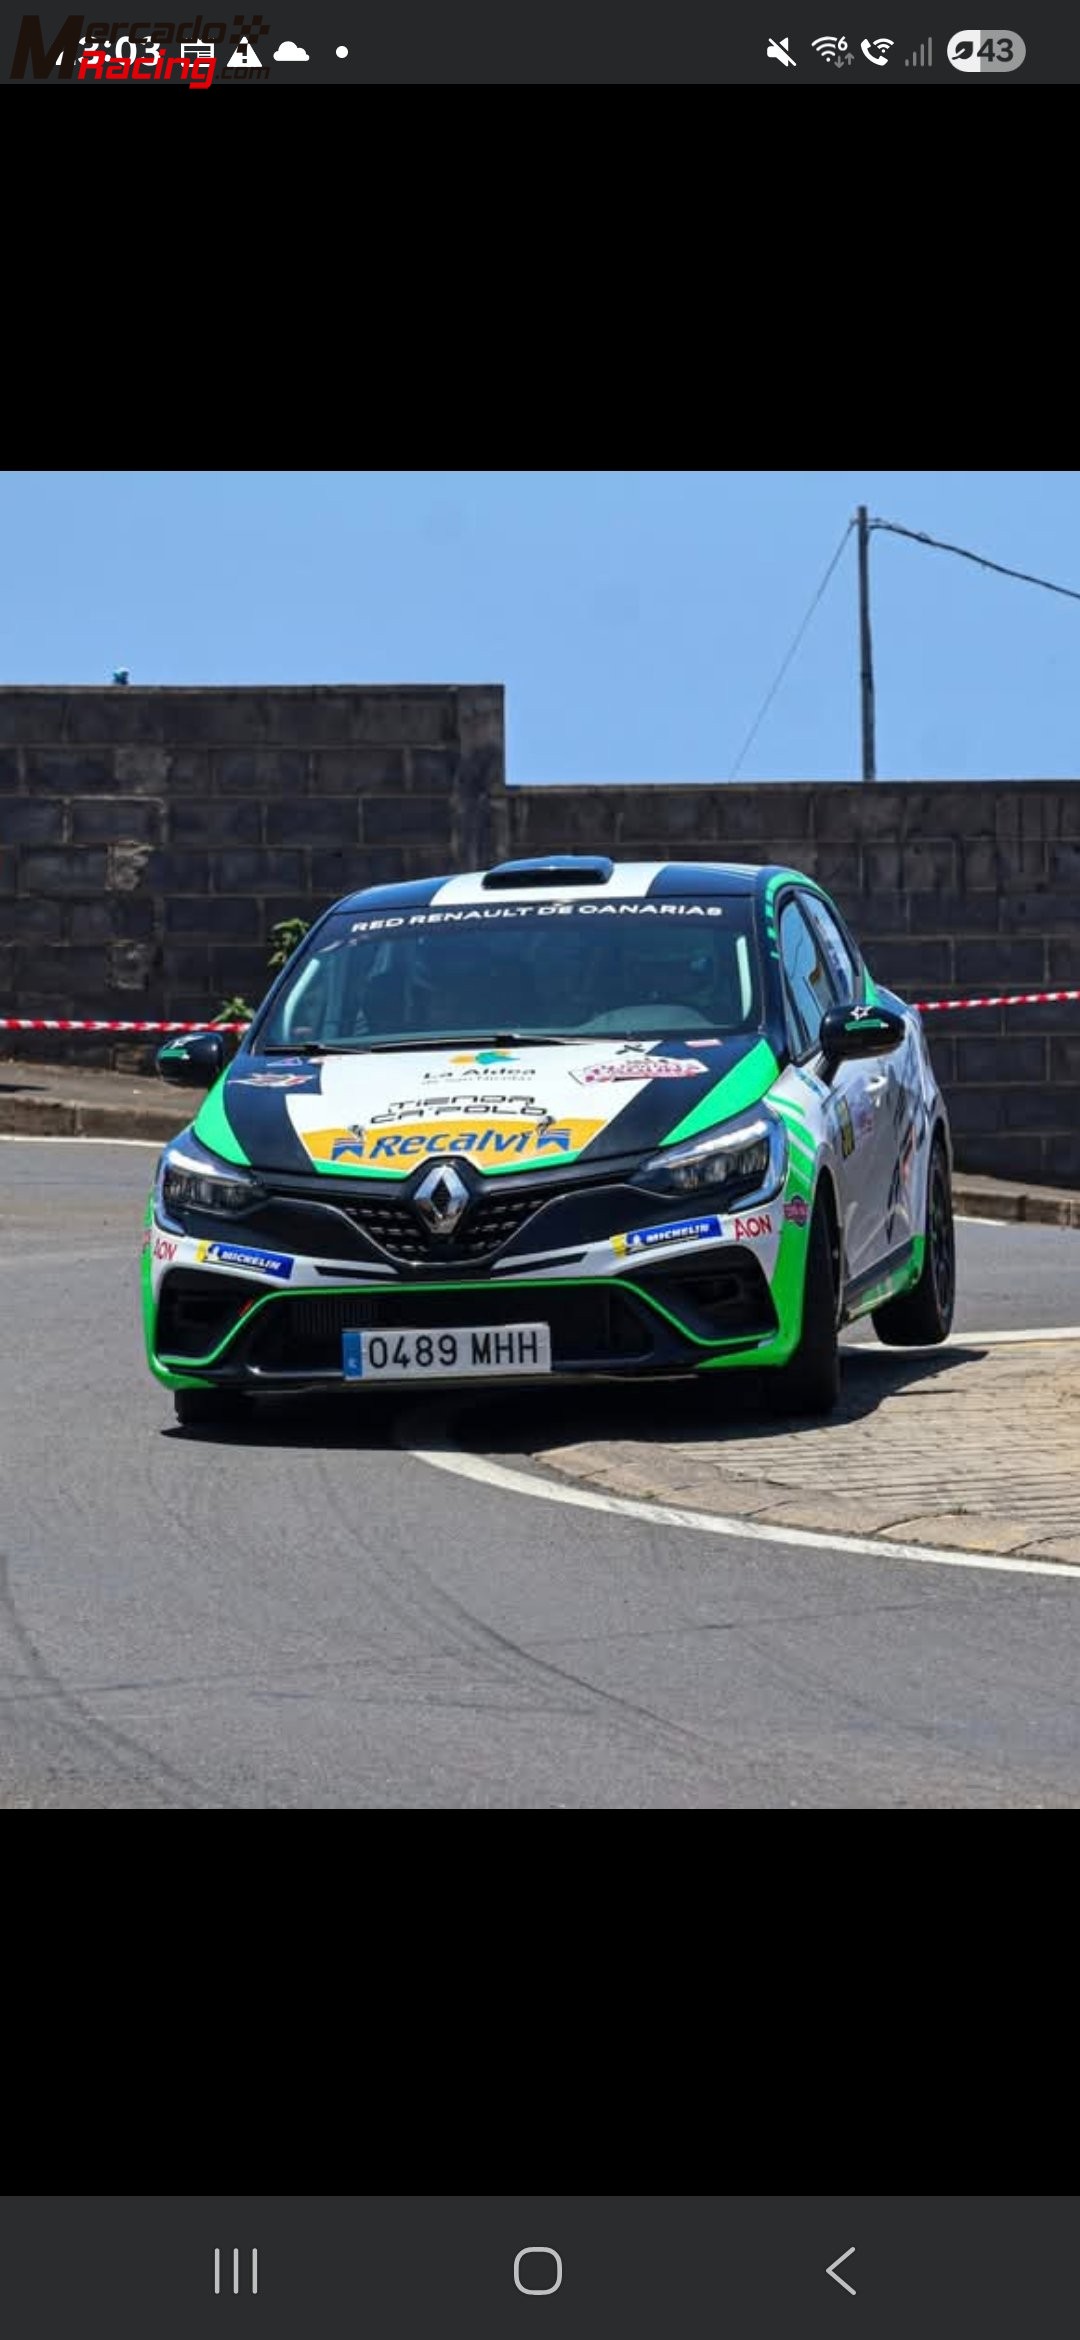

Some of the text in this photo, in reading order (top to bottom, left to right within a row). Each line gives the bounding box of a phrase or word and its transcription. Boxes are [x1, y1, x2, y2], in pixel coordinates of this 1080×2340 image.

[837, 36, 848, 51] 6
[976, 38, 1014, 63] 43
[351, 903, 723, 933] RED RENAULT DE CANARIAS
[369, 1129, 533, 1160] Recalvi
[646, 1223, 710, 1243] MICHELIN
[733, 1214, 772, 1242] AON
[220, 1251, 282, 1270] MICHELIN
[368, 1331, 538, 1369] 0489 MHH
